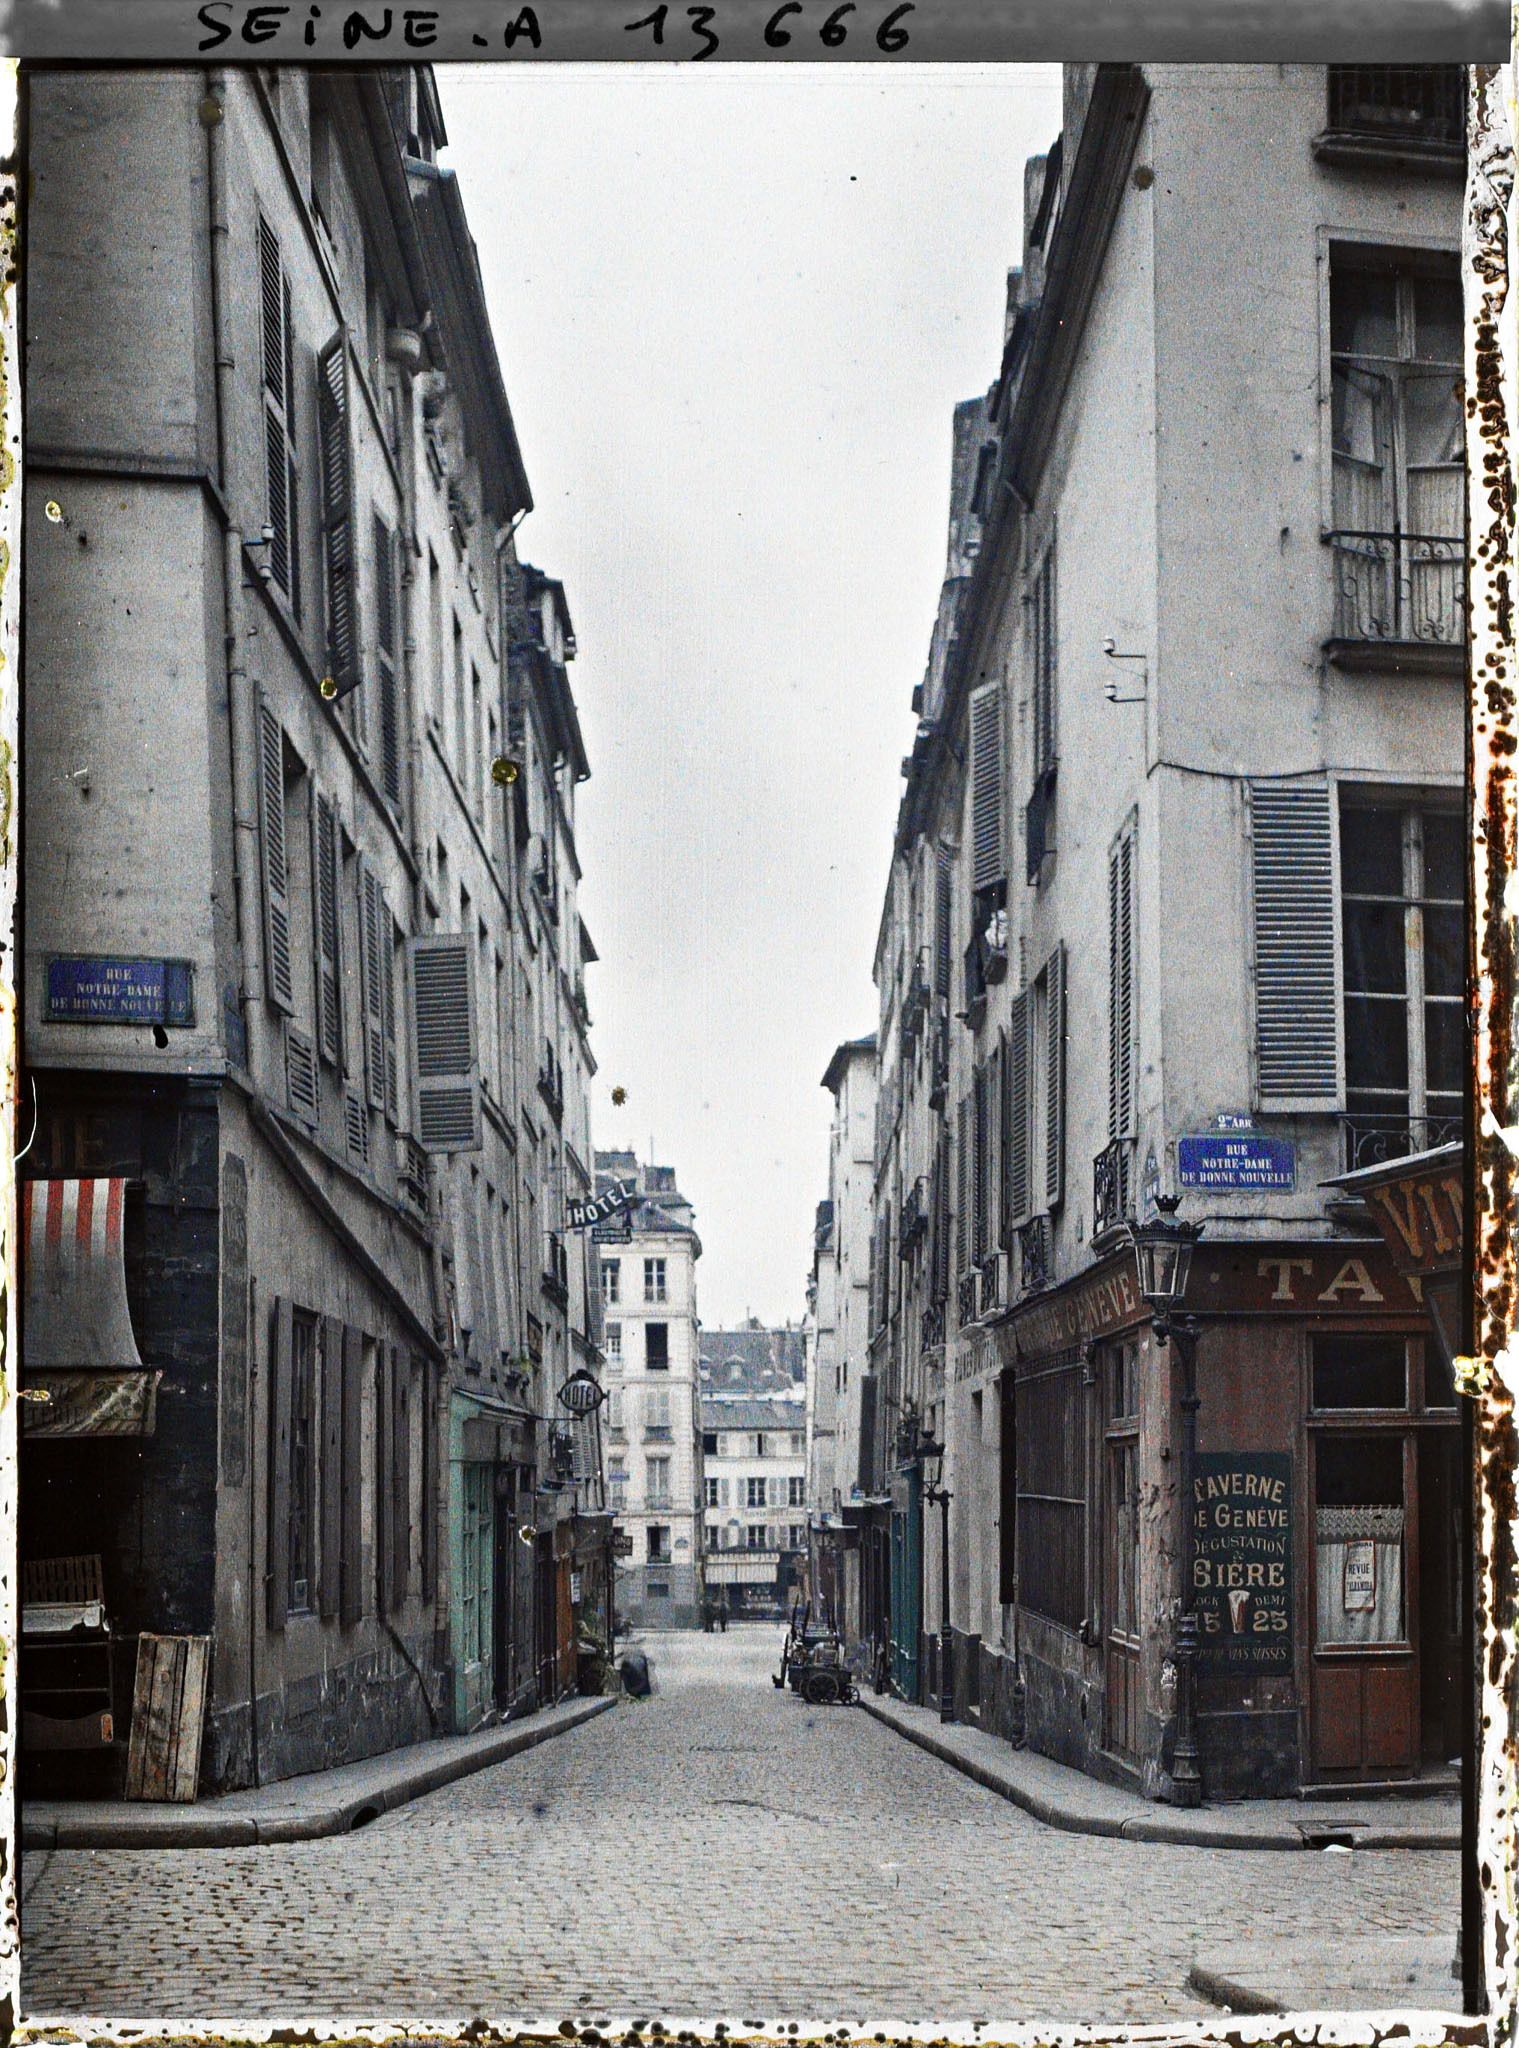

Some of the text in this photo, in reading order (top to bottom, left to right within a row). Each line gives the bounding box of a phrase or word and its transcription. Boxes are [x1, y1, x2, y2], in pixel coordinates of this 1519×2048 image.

[106, 967, 132, 980] RUE
[76, 982, 162, 998] NOTRE-DAME
[51, 996, 187, 1012] DE BONNE NOUVELE
[1226, 1144, 1248, 1155] RUE
[1202, 1158, 1273, 1170] NOTRE-DAME
[1181, 1172, 1293, 1184] DE BONNE NOUVELLE
[573, 1182, 634, 1225] HOTEL
[564, 1385, 599, 1408] HOTEL
[1194, 1510, 1207, 1527] E
[1348, 1563, 1370, 1574] REVUE
[1194, 1597, 1219, 1607] OCK
[1253, 1610, 1288, 1632] 25
